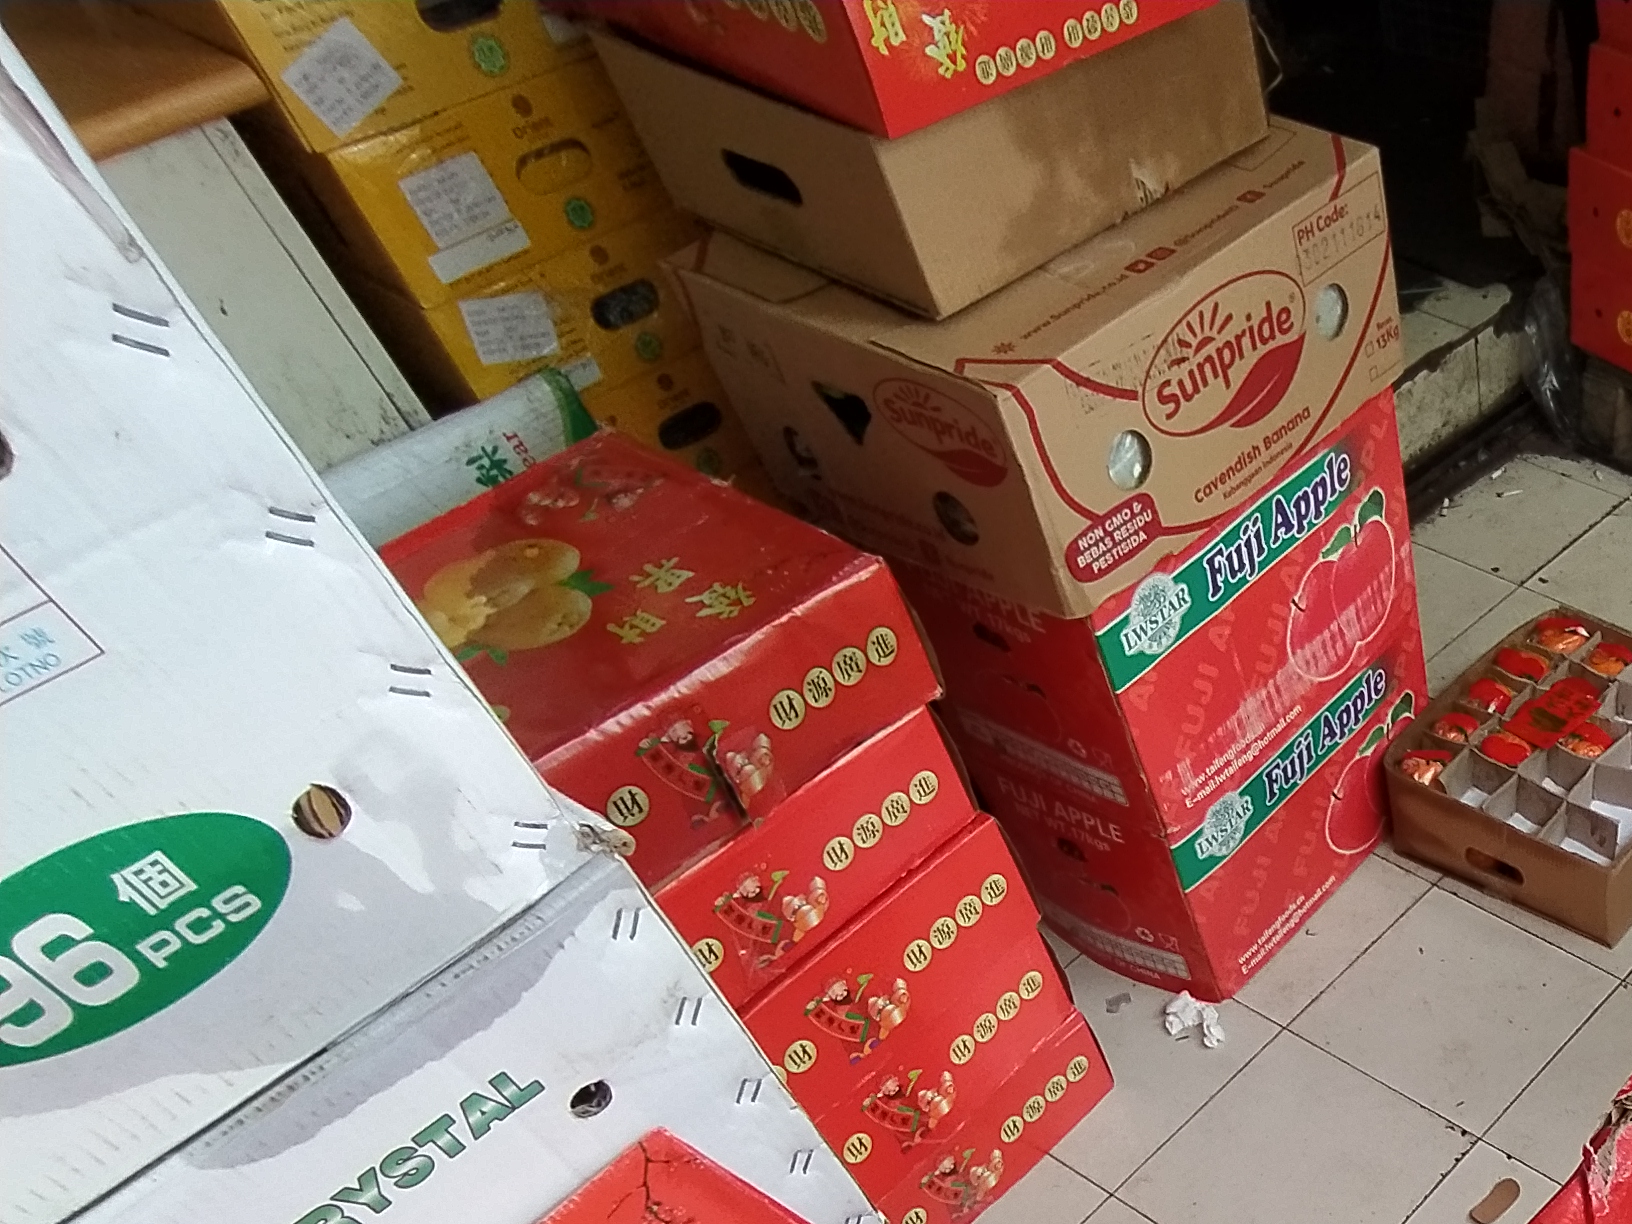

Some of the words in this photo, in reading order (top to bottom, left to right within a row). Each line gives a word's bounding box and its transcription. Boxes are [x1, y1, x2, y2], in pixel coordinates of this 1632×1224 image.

[1296, 220, 1316, 246] PH
[1315, 203, 1349, 232] Code:
[1156, 300, 1295, 421] Sunpride
[884, 398, 998, 458] Sunpride
[1262, 405, 1312, 454] Banana
[1076, 527, 1104, 551] NON
[1104, 511, 1133, 533] GMO
[1132, 501, 1143, 517] &
[1076, 538, 1114, 570] BEBAS
[1112, 509, 1153, 544] RESIDU
[1091, 531, 1149, 575] PESTISIDA
[1204, 515, 1268, 602] Fuji
[1270, 452, 1350, 548] Apple
[629, 556, 696, 594] 果
[684, 581, 757, 620] 發
[606, 608, 667, 645] 財
[1121, 583, 1191, 656] LWSTAR
[610, 789, 646, 823] 財
[771, 630, 896, 728] 財源廣進
[1262, 732, 1316, 806] Fuji
[1317, 667, 1387, 756] Apple
[825, 774, 936, 870] 財源廣進
[1054, 801, 1126, 844] APPLE
[1195, 794, 1254, 860] LWSTAR
[110, 849, 198, 916] 個
[134, 884, 263, 969] PCS
[786, 1042, 814, 1071] 財
[905, 877, 1006, 970] 財源廣進
[845, 1135, 870, 1161] 財
[951, 973, 1042, 1063] 財源廣進
[1001, 1058, 1089, 1141] 財源廣進
